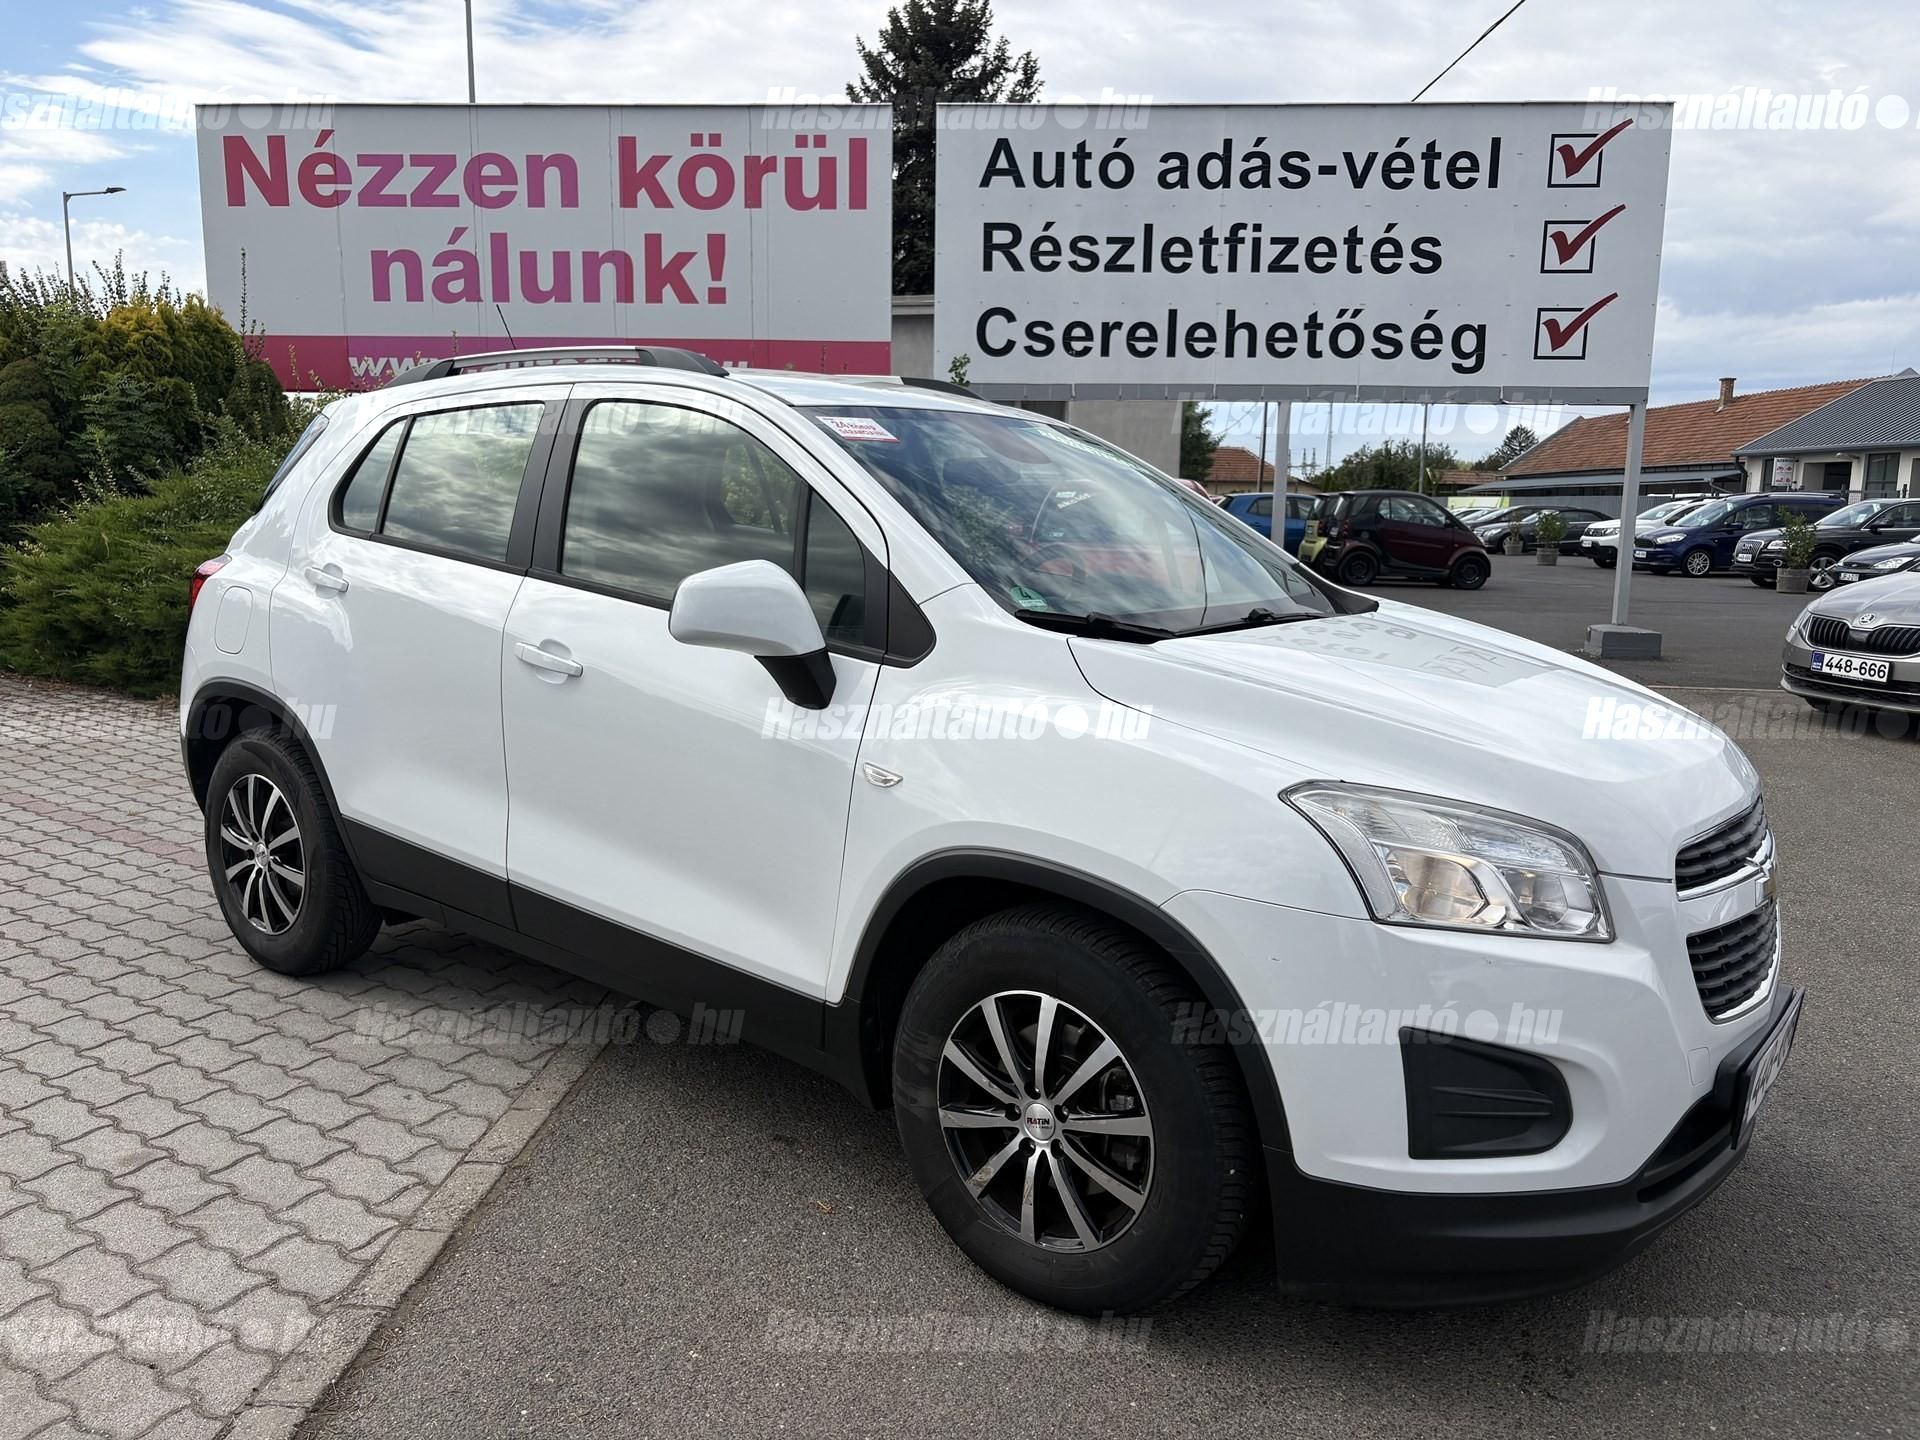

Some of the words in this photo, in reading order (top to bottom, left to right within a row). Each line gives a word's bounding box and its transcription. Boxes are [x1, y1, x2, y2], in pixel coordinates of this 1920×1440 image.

[223, 130, 579, 210] Nézzen
[618, 133, 868, 212] körül
[979, 137, 1135, 190] Autó
[1157, 137, 1502, 191] adás-vétel
[370, 227, 727, 305] nálunk!
[982, 221, 1443, 275] Részletfizetés
[975, 306, 1487, 375] Cserelehetőség
[1825, 656, 1887, 679] 448-666
